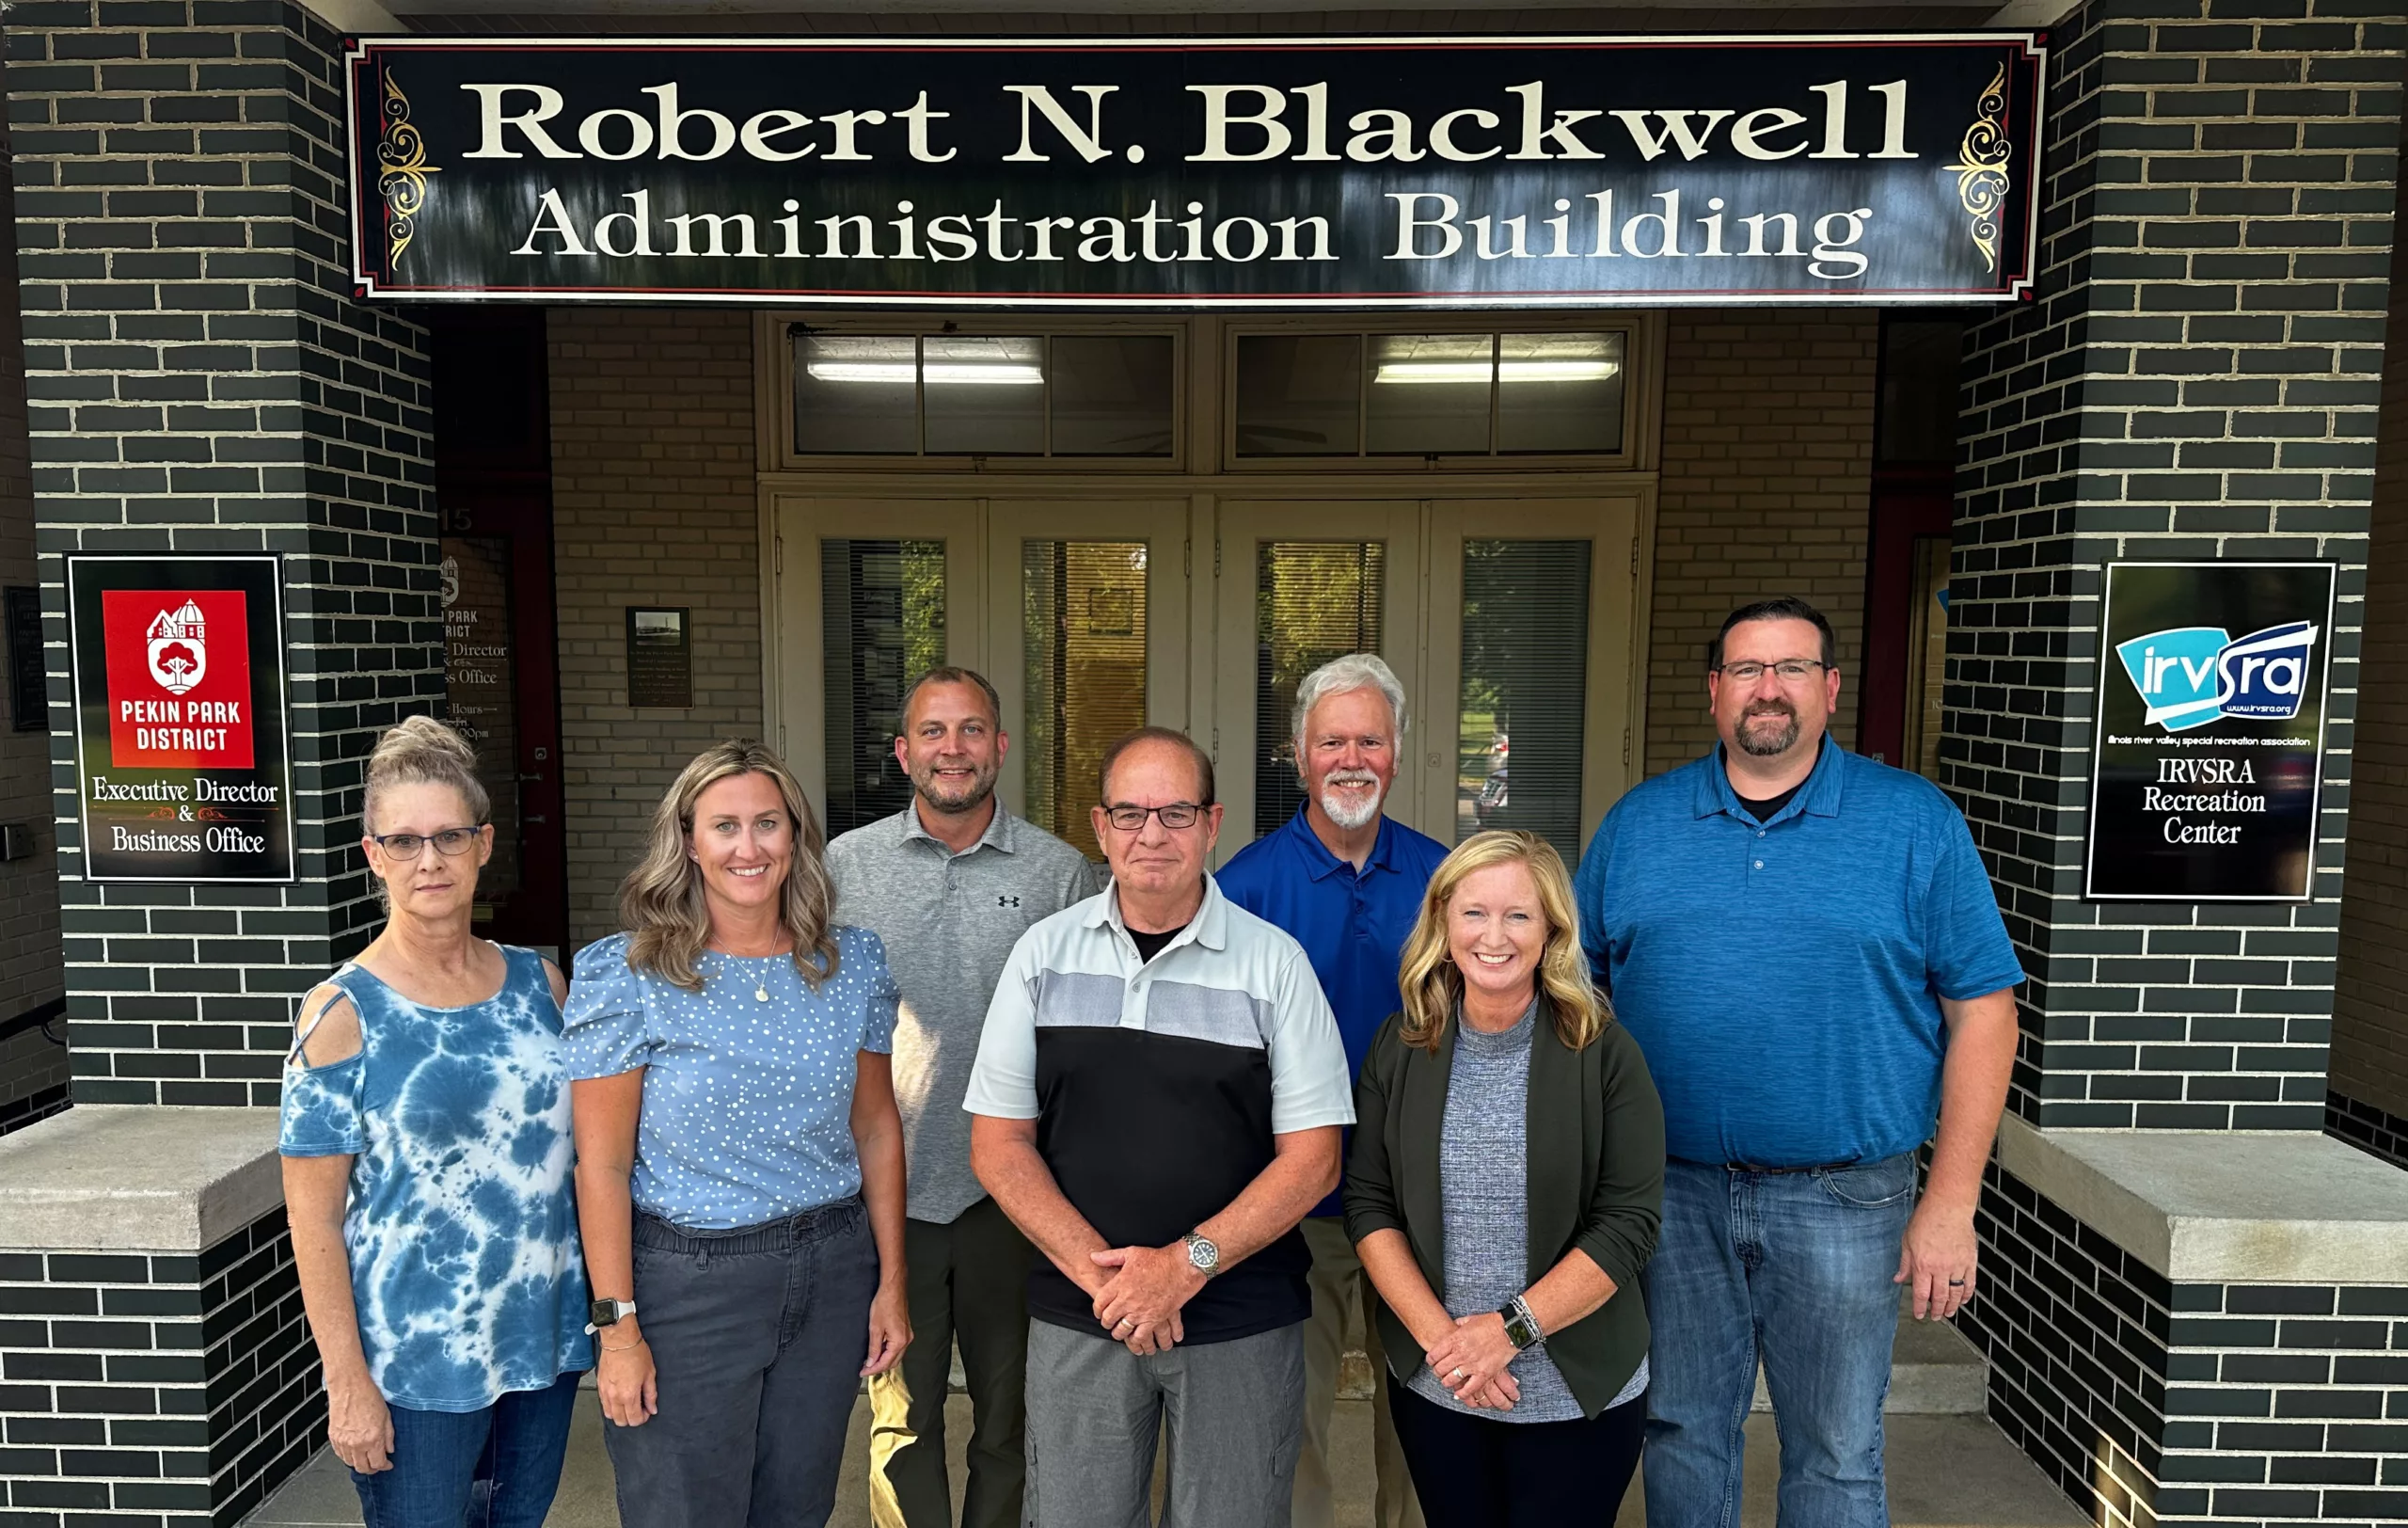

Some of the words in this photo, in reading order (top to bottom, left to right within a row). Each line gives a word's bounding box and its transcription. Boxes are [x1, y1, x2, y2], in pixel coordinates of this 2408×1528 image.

[459, 81, 958, 163] Robert
[1002, 85, 1145, 164] N.
[1184, 79, 1920, 163] Blackwell
[509, 187, 1339, 263] Administration
[1382, 188, 1873, 279] Building
[449, 610, 478, 624] PARK
[442, 625, 470, 638] RICT
[453, 643, 507, 657] Director
[459, 669, 498, 684] Office
[121, 700, 181, 723] PEKIN
[187, 701, 241, 724] PARK
[2226, 705, 2291, 716] www.irvsra.org
[136, 727, 228, 751] DISTRICT
[2133, 736, 2154, 745] river
[2155, 735, 2181, 748] valley
[2182, 736, 2212, 748] special
[2214, 736, 2258, 746] recreation
[2260, 737, 2311, 746] association
[2156, 757, 2257, 785] IRVSRA
[91, 775, 189, 802] Executive
[193, 777, 278, 803] Director
[2142, 786, 2267, 813] Recreation
[178, 804, 195, 822] &
[110, 825, 201, 852] Business
[205, 826, 265, 853] Office
[2163, 816, 2242, 844] Center
